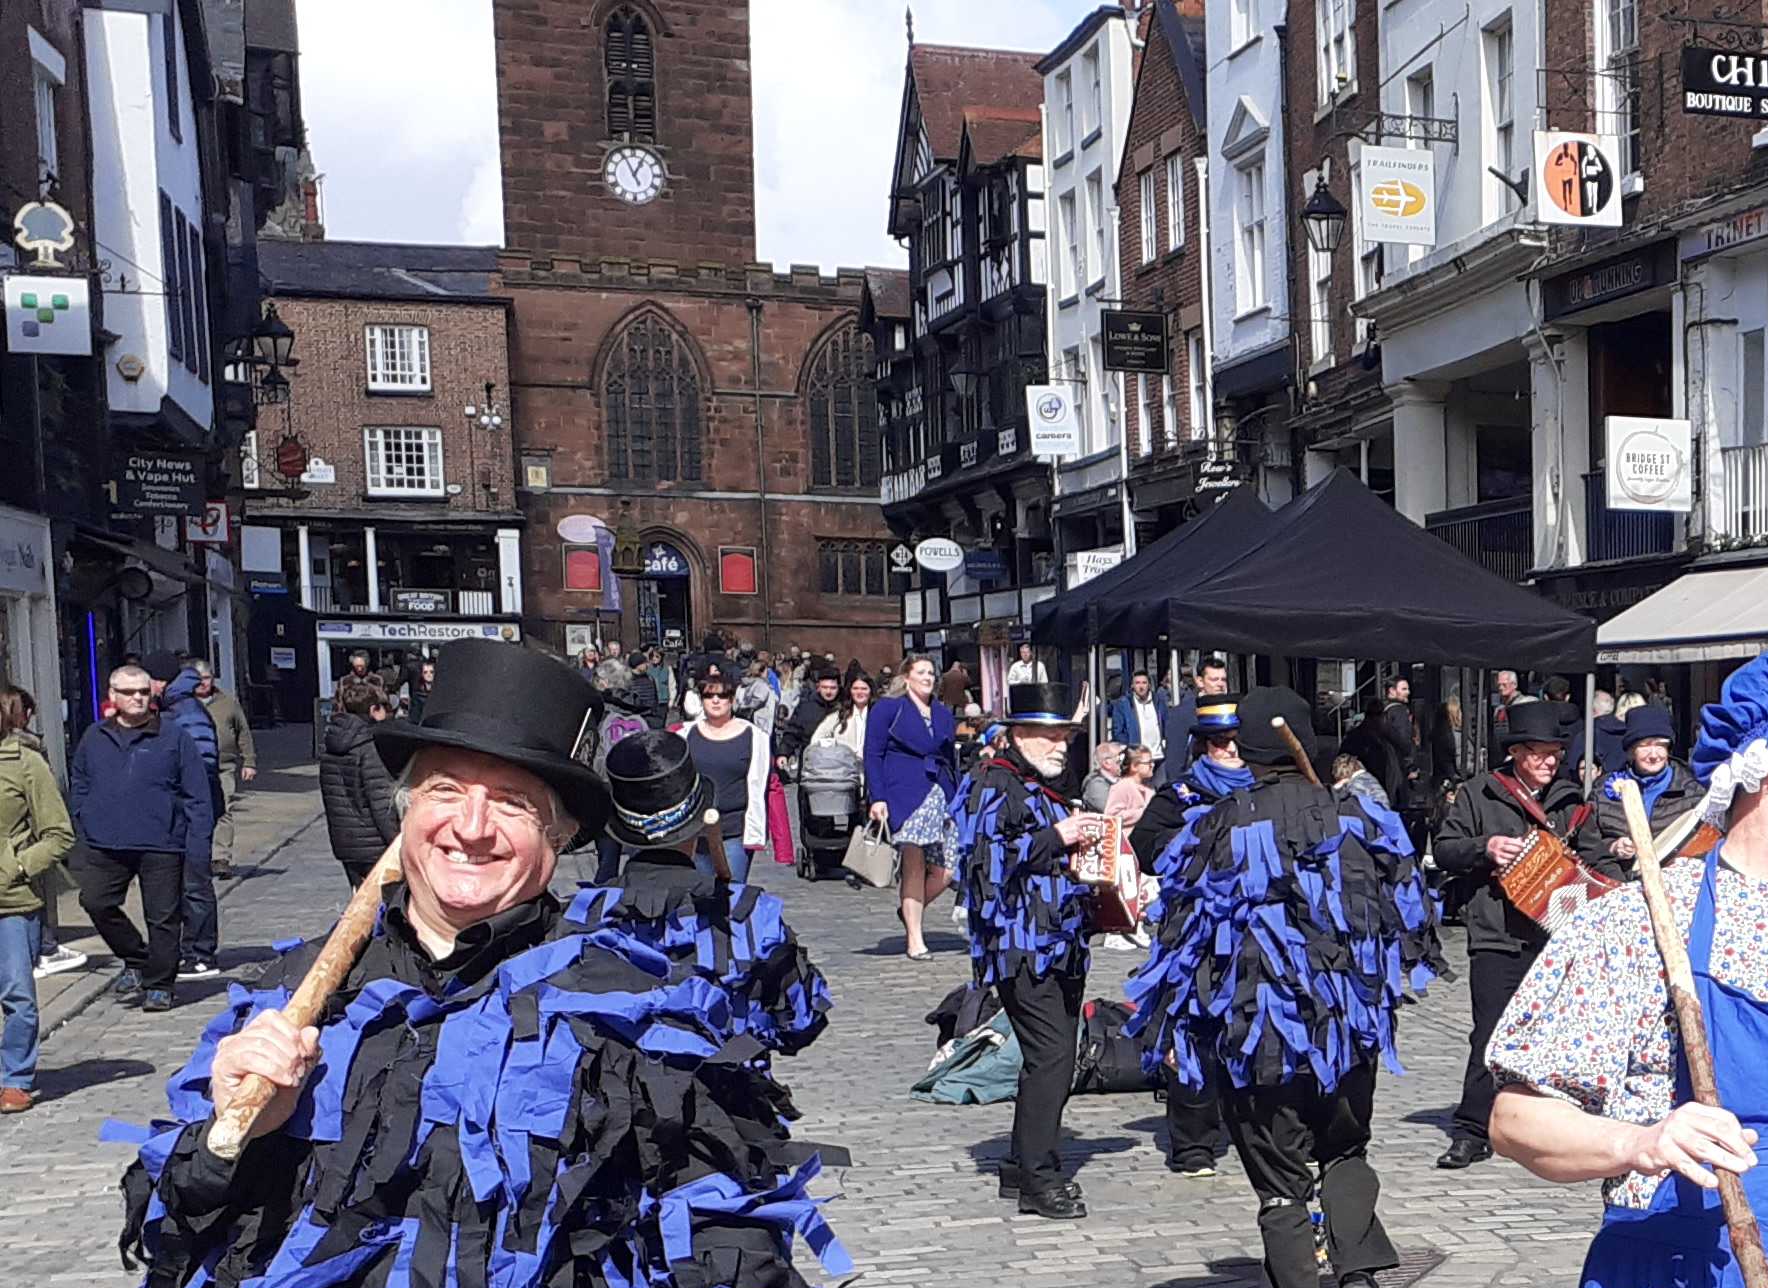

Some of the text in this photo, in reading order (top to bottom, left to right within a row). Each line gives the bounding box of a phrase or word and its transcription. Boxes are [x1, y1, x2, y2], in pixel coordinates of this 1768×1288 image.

[1686, 91, 1752, 113] BOUTIQUE
[1367, 159, 1430, 172] TRAILFINDERS
[129, 457, 192, 471] City News
[1626, 452, 1671, 465] BRIDGE ST
[125, 469, 195, 483] & Vape Hut
[1632, 464, 1665, 476] COFFEE
[920, 546, 961, 558] POWELLS
[1086, 554, 1113, 566] Hays
[378, 623, 476, 638] TechRestore
